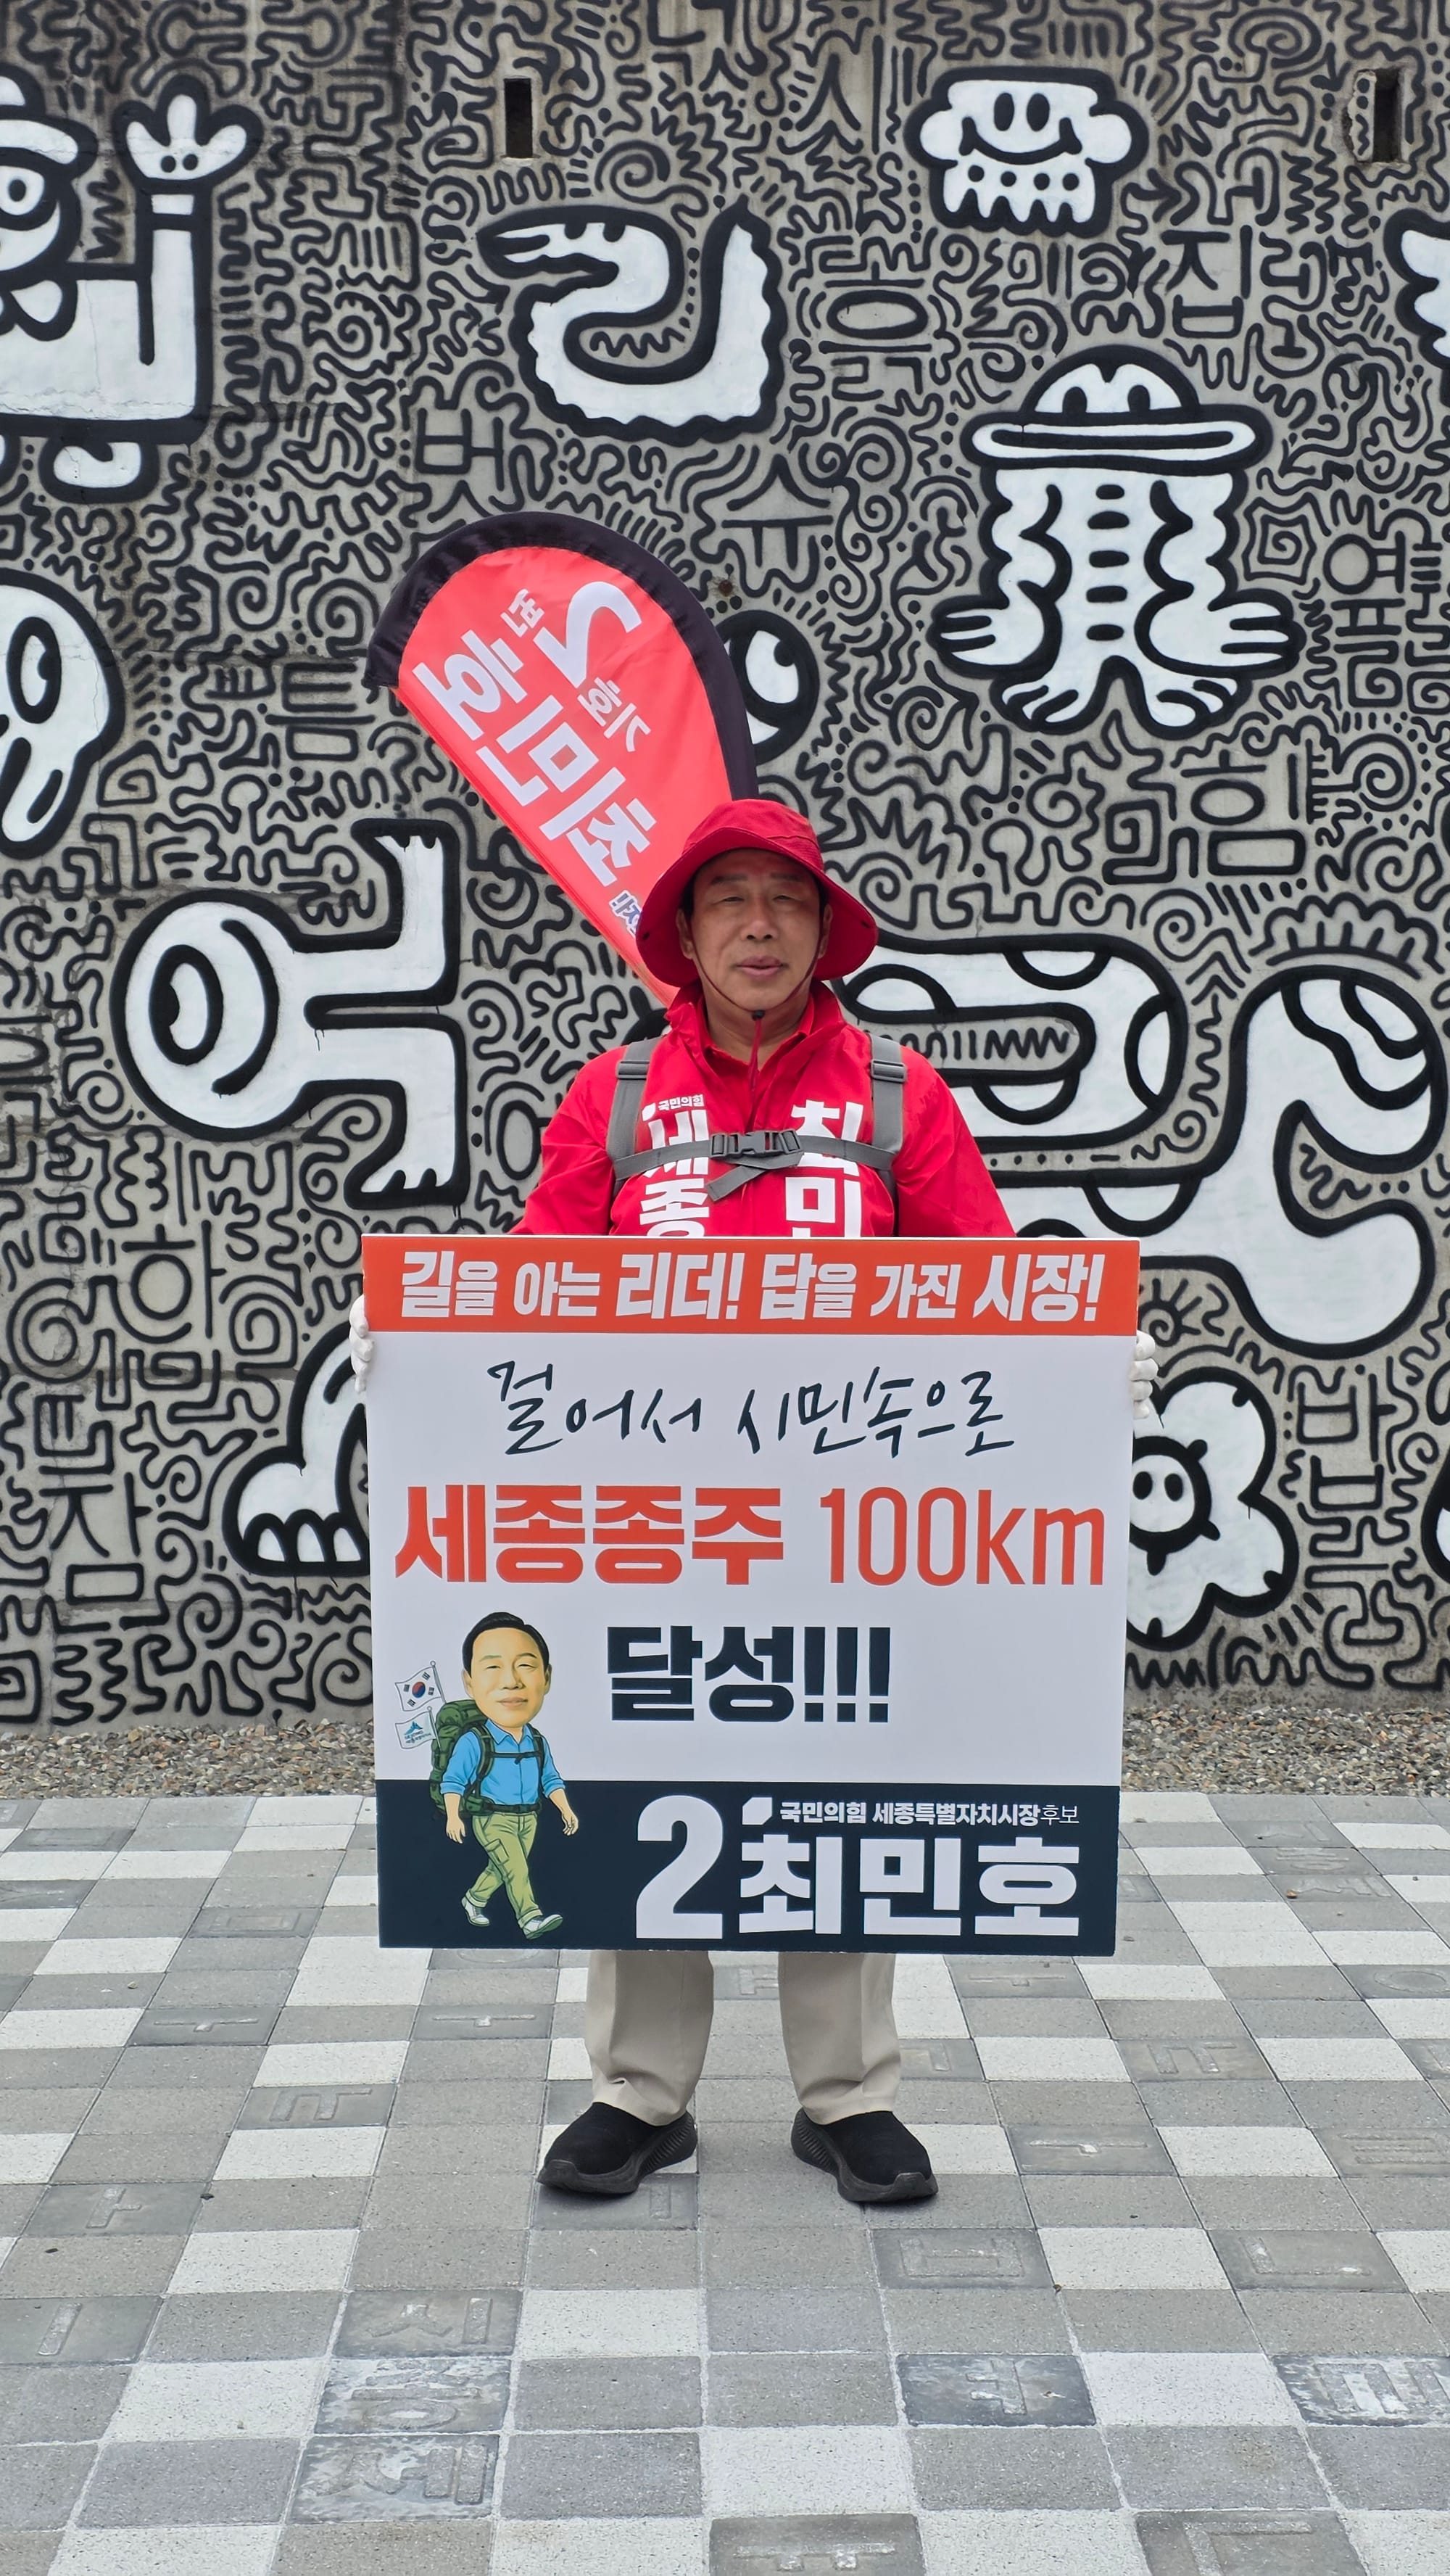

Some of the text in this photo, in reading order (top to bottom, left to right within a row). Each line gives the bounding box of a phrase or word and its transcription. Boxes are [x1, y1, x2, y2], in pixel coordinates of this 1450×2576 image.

[658, 1094, 705, 1112] 국민의힘
[401, 1250, 1106, 1322] 길을 아는 리더! 답을 가진 시장!
[487, 1361, 702, 1455] 걸어서
[394, 1485, 1105, 1587] 세종종주 100km
[608, 1625, 891, 1723] 달성!!!
[779, 1801, 867, 1825] 국민의힘
[636, 1795, 1080, 1939] 2 최민호
